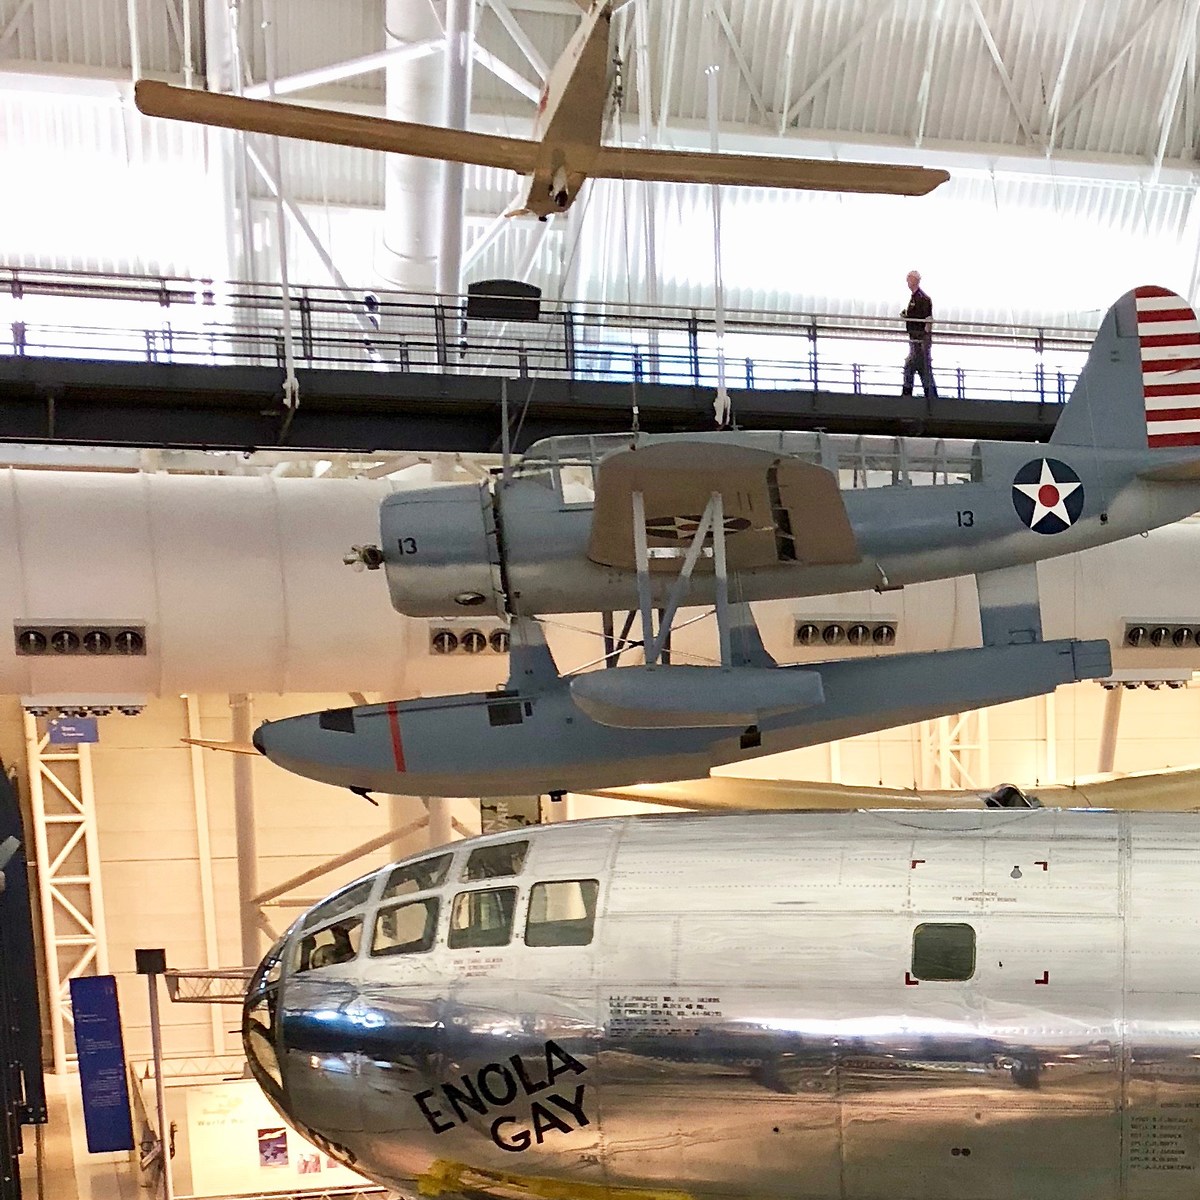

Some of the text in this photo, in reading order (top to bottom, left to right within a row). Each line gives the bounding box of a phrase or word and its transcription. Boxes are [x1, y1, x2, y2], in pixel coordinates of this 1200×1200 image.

[957, 510, 974, 527] 13
[398, 537, 418, 555] 13
[413, 1040, 587, 1134] ENOLA
[490, 1084, 590, 1152] GAY
